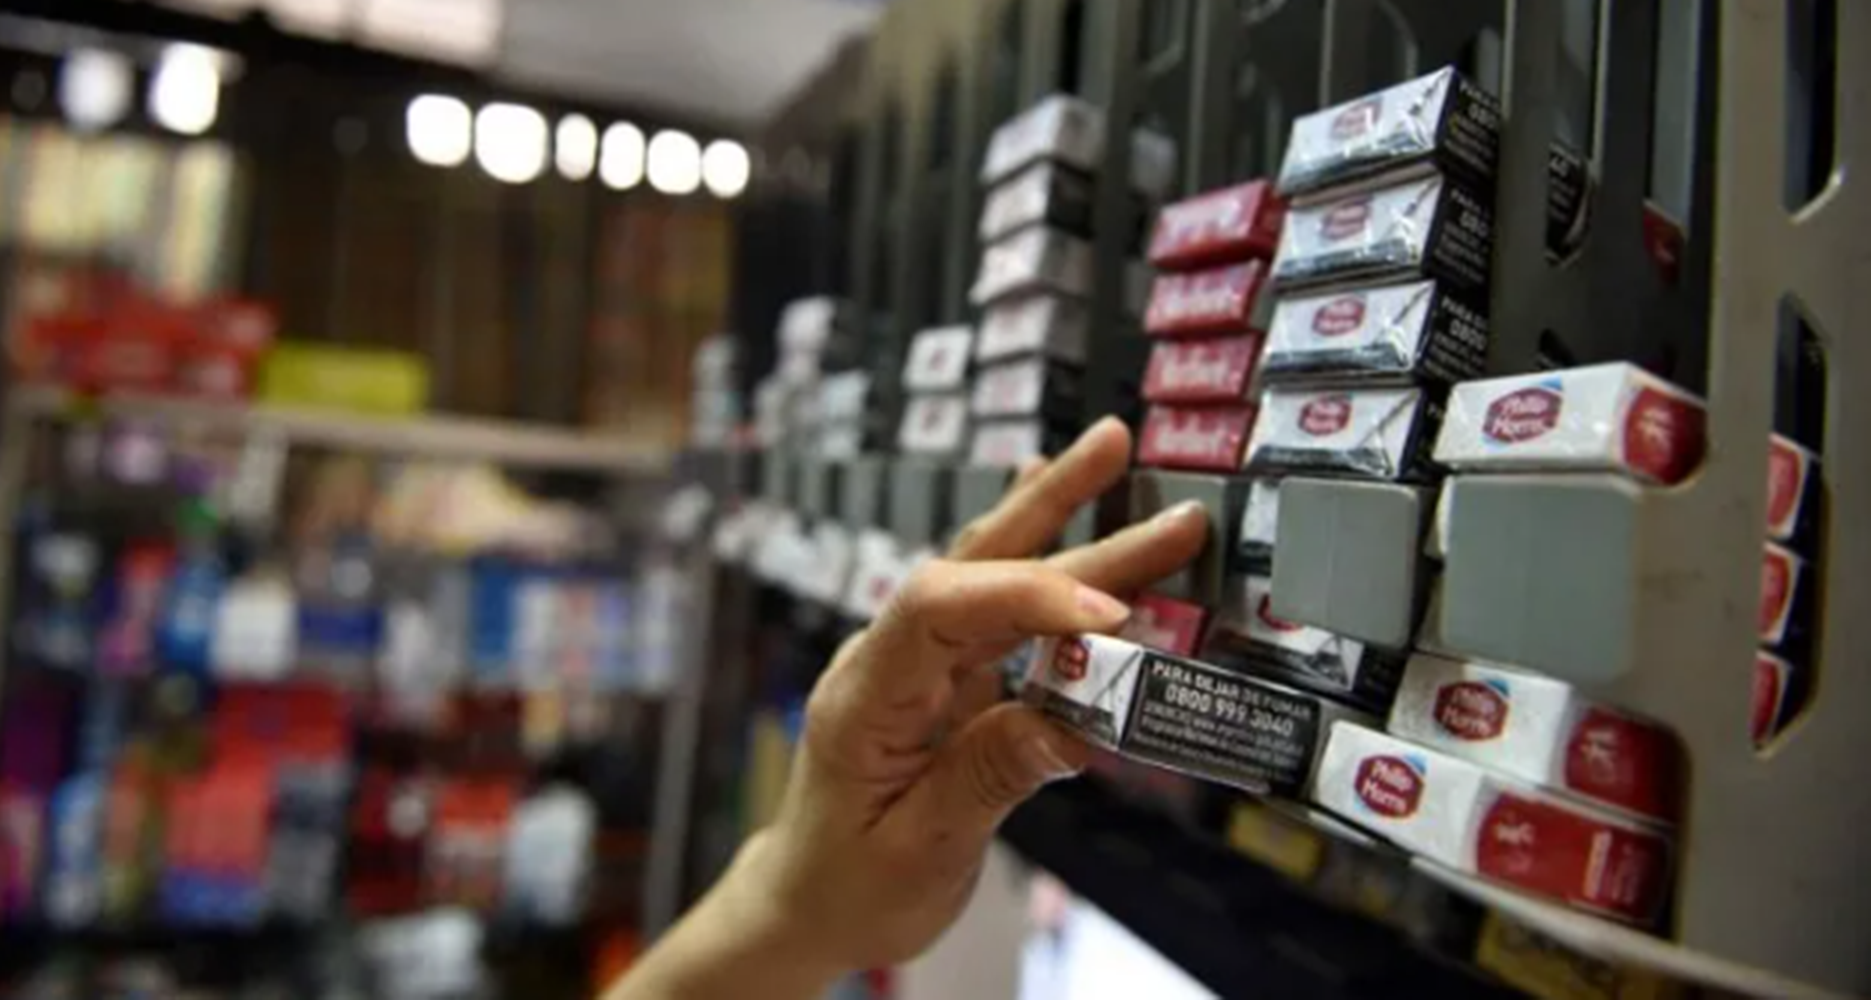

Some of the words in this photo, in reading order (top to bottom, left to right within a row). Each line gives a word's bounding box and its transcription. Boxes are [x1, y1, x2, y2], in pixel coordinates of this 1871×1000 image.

[1152, 660, 1192, 684] PARA
[1194, 673, 1239, 696] DEJAR
[1241, 687, 1260, 706] DE
[1263, 694, 1312, 720] FUMAR
[1164, 683, 1212, 713] 0800
[1215, 698, 1248, 722] 999
[1249, 709, 1294, 736] 3040
[1362, 777, 1407, 813] Morris
[1371, 760, 1413, 792] Philip
